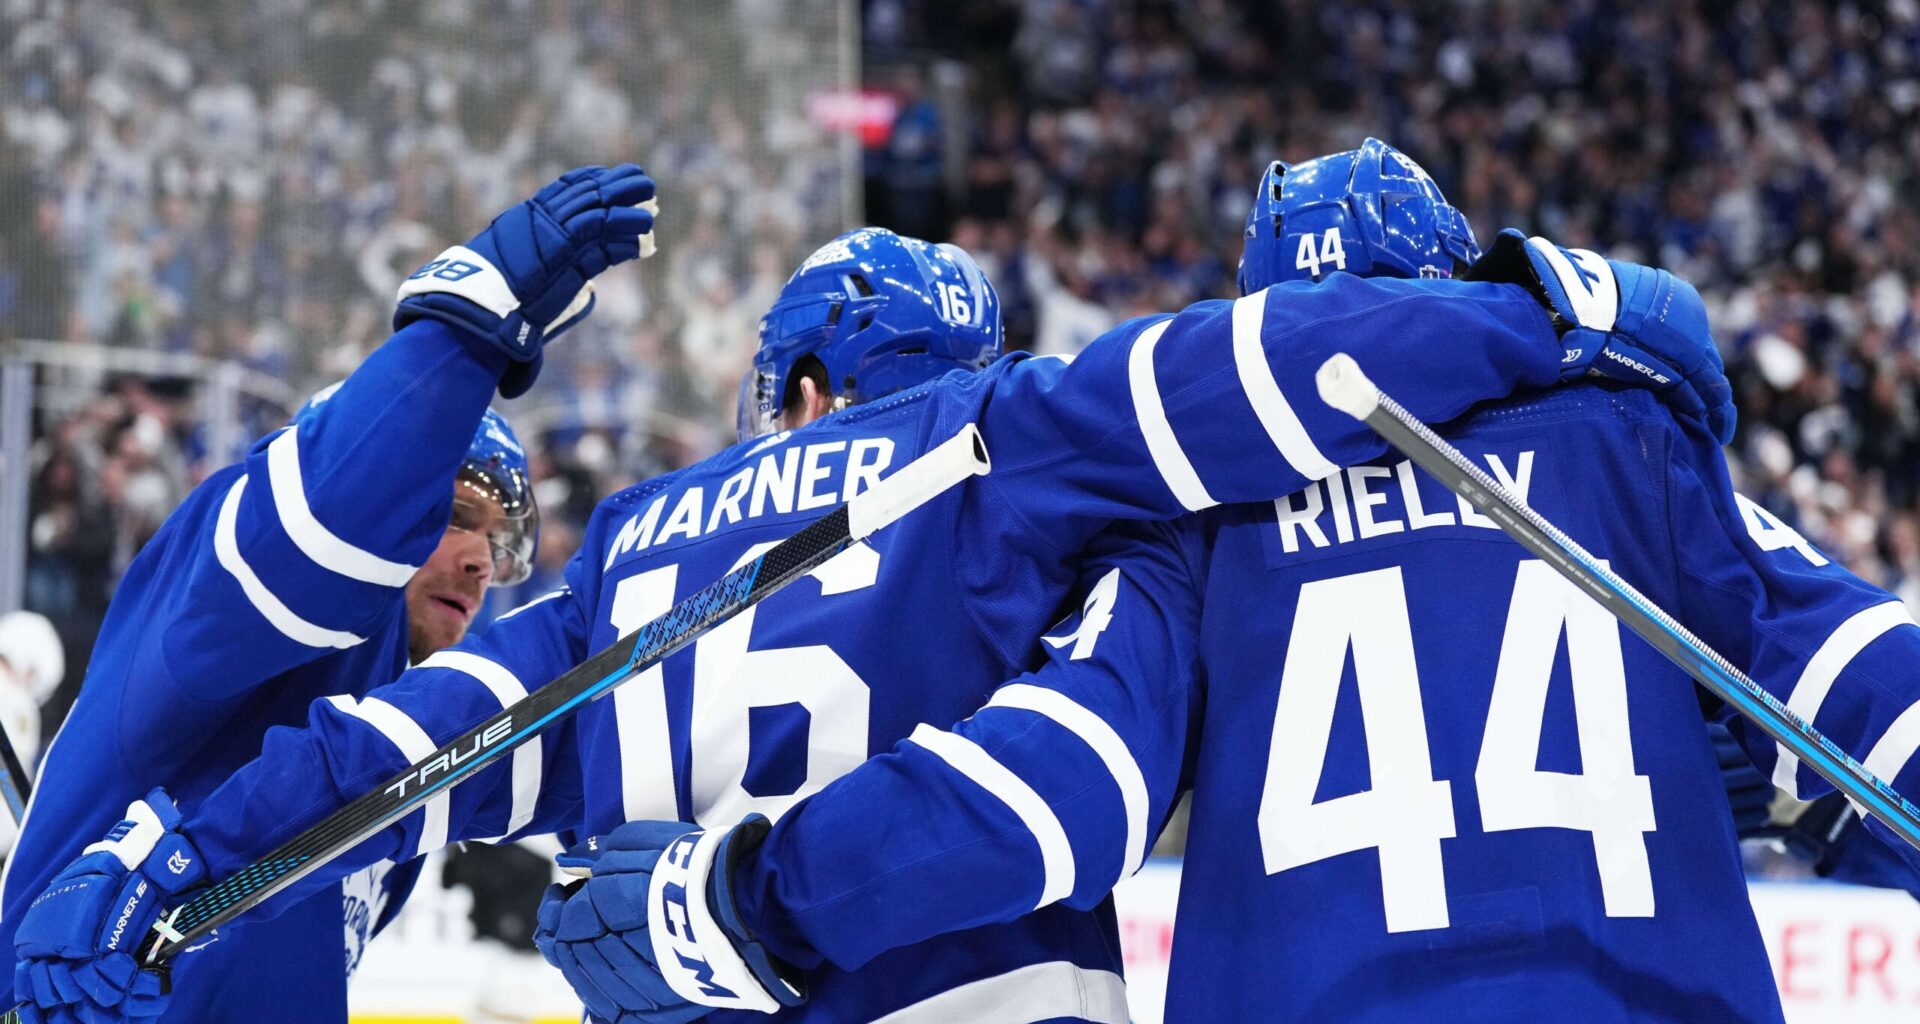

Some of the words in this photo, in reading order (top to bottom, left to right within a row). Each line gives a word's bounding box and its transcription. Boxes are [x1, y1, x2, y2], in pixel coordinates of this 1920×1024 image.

[1295, 226, 1347, 277] 44
[935, 281, 971, 324] 16
[1602, 346, 1655, 378] MARNER
[603, 436, 896, 573] MARNER
[609, 538, 881, 831] 16
[383, 714, 512, 799] TRUE
[1257, 559, 1657, 934] 44
[107, 896, 140, 950] MARNER
[135, 879, 148, 899] 16
[662, 832, 741, 1000] CCM
[1781, 923, 1920, 1002] ER
